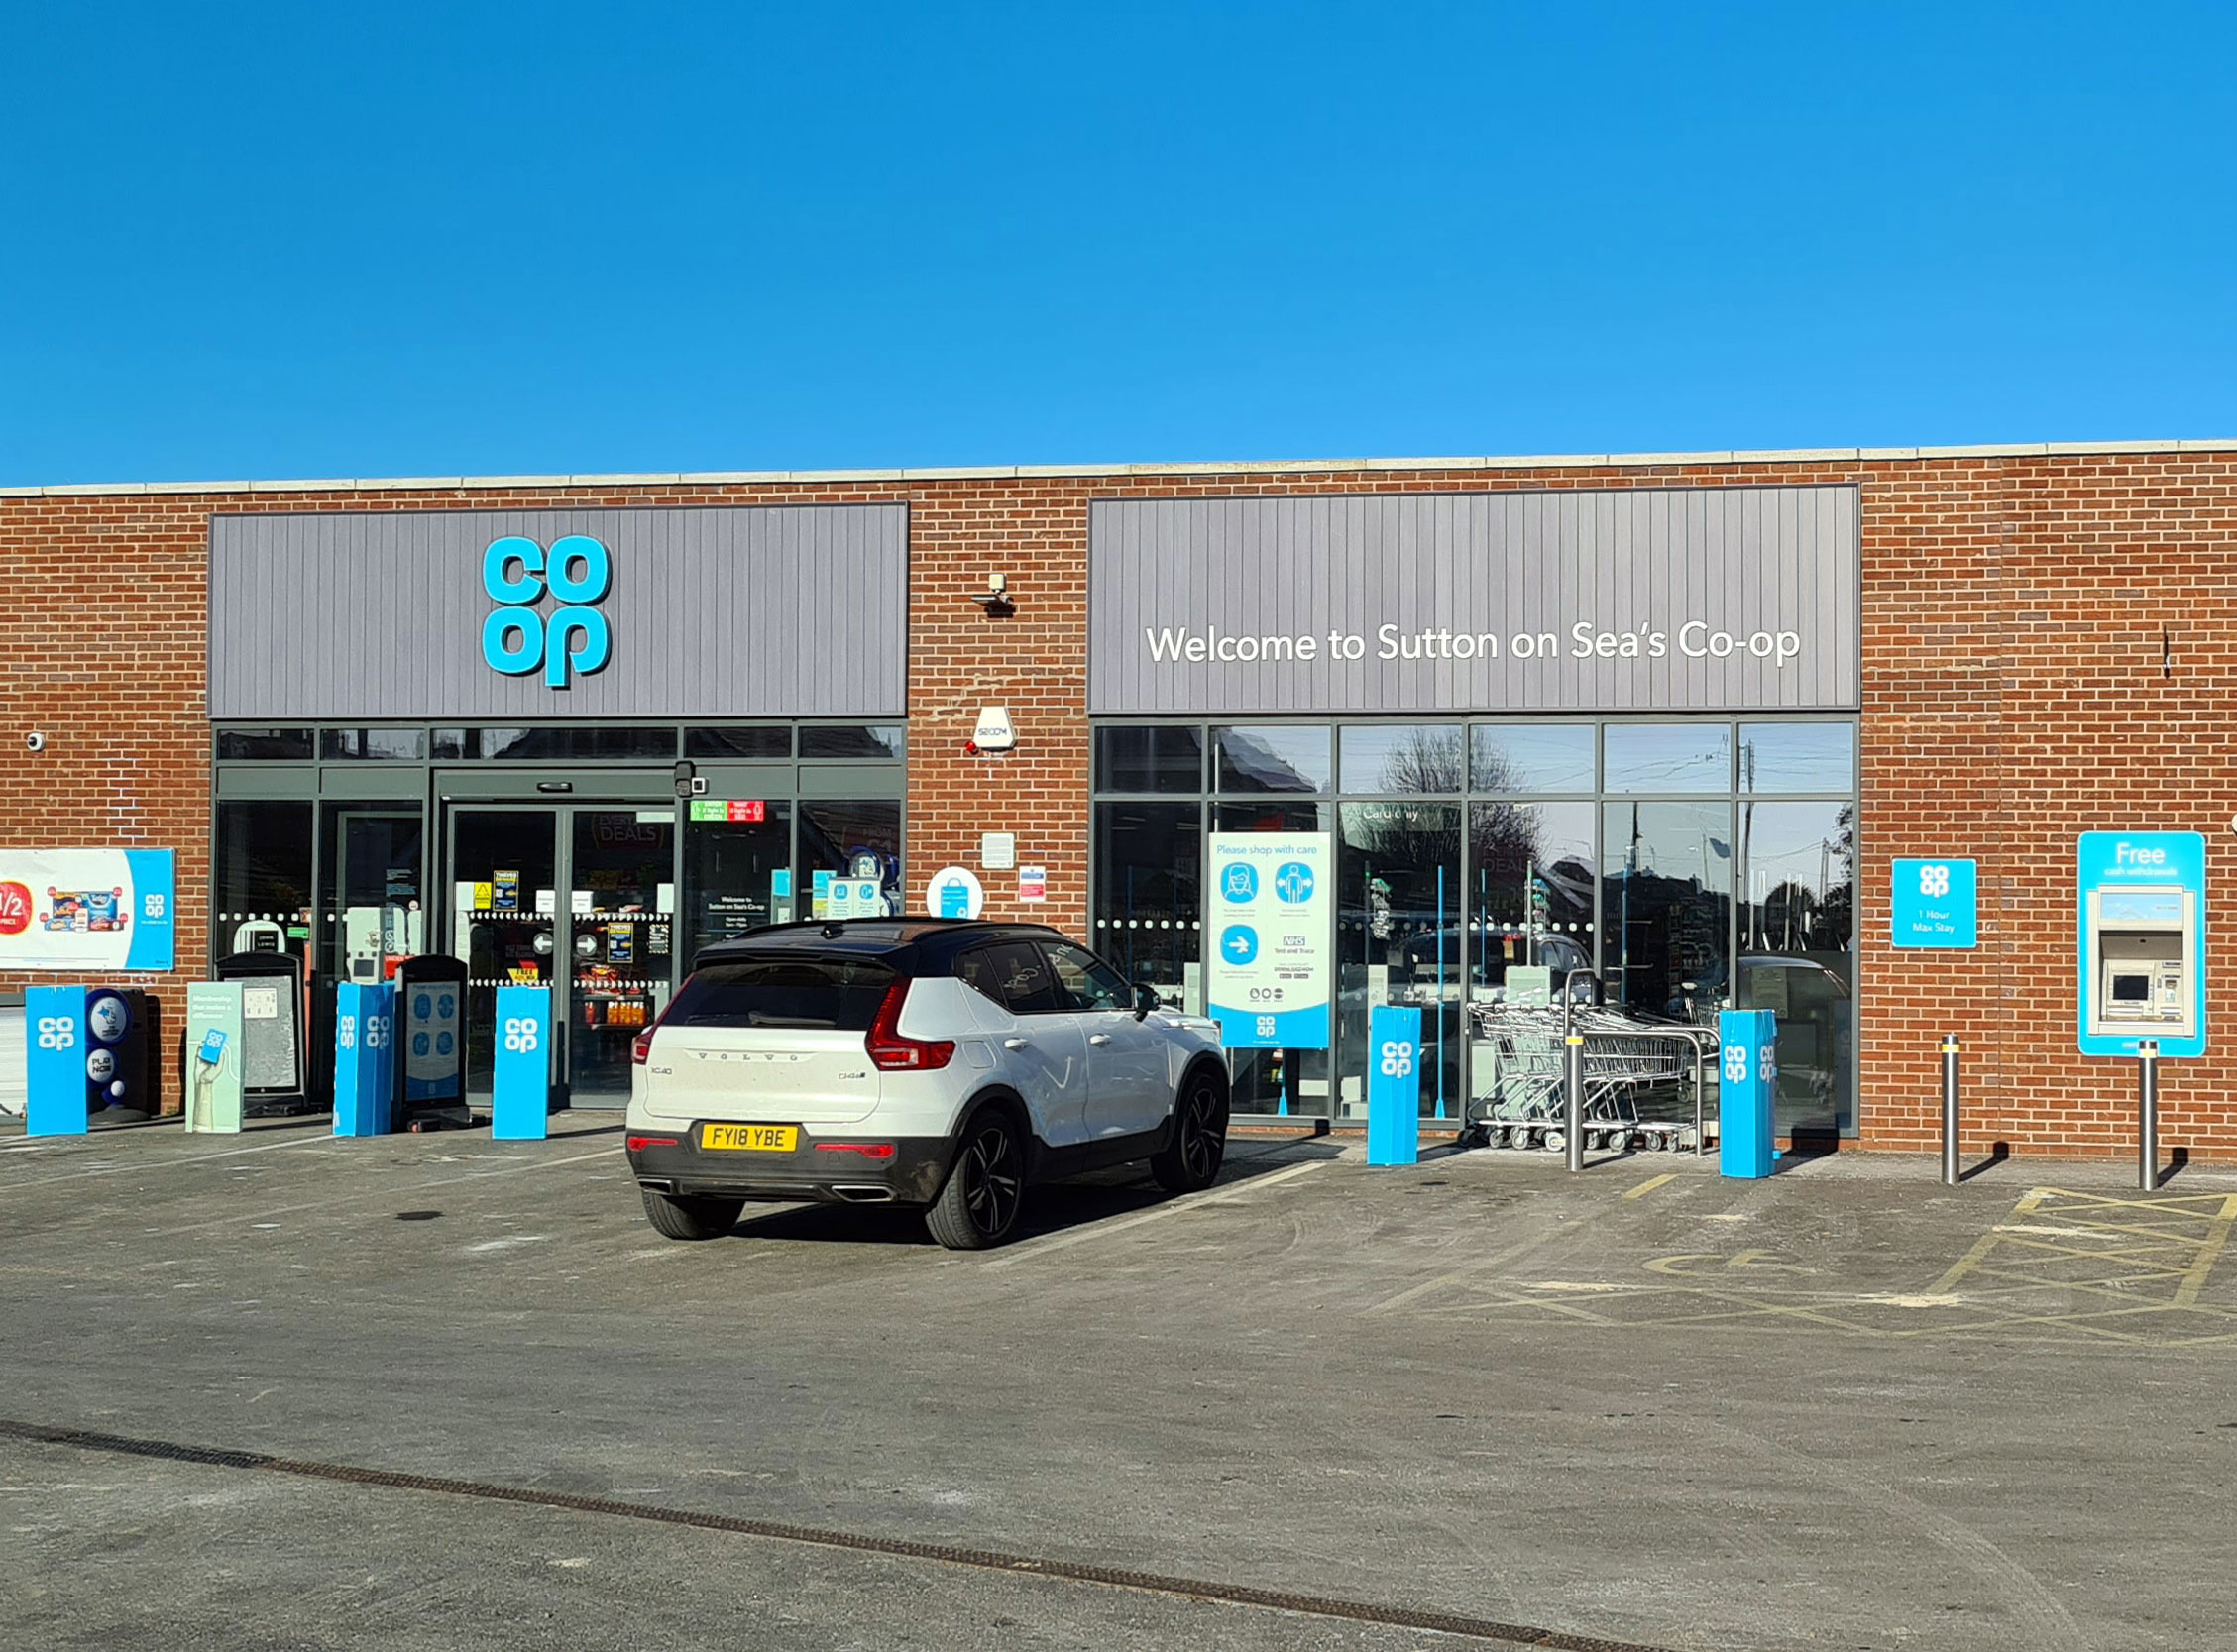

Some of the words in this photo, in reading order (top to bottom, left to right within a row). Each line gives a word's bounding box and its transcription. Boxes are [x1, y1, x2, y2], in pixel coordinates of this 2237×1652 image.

[1145, 625, 1317, 662] Welcome
[1327, 630, 1365, 660] to
[1378, 623, 1498, 659] Sutton
[1511, 633, 1557, 658] on
[1571, 621, 1666, 658] Sea's
[1679, 620, 1800, 667] Co-op
[600, 826, 656, 841] DEALS
[1216, 844, 1247, 854] Please
[1249, 845, 1272, 857] shop
[1274, 844, 1295, 854] with
[2116, 842, 2166, 864] Free
[1483, 858, 1527, 873] DEAL
[1926, 910, 1950, 919] Hour
[1912, 923, 1933, 932] Max
[1935, 922, 1955, 935] Stay
[1284, 936, 1305, 945] NHS
[699, 1052, 798, 1061] VOLVO
[713, 1128, 748, 1146] FY18
[753, 1129, 786, 1147] YBE
